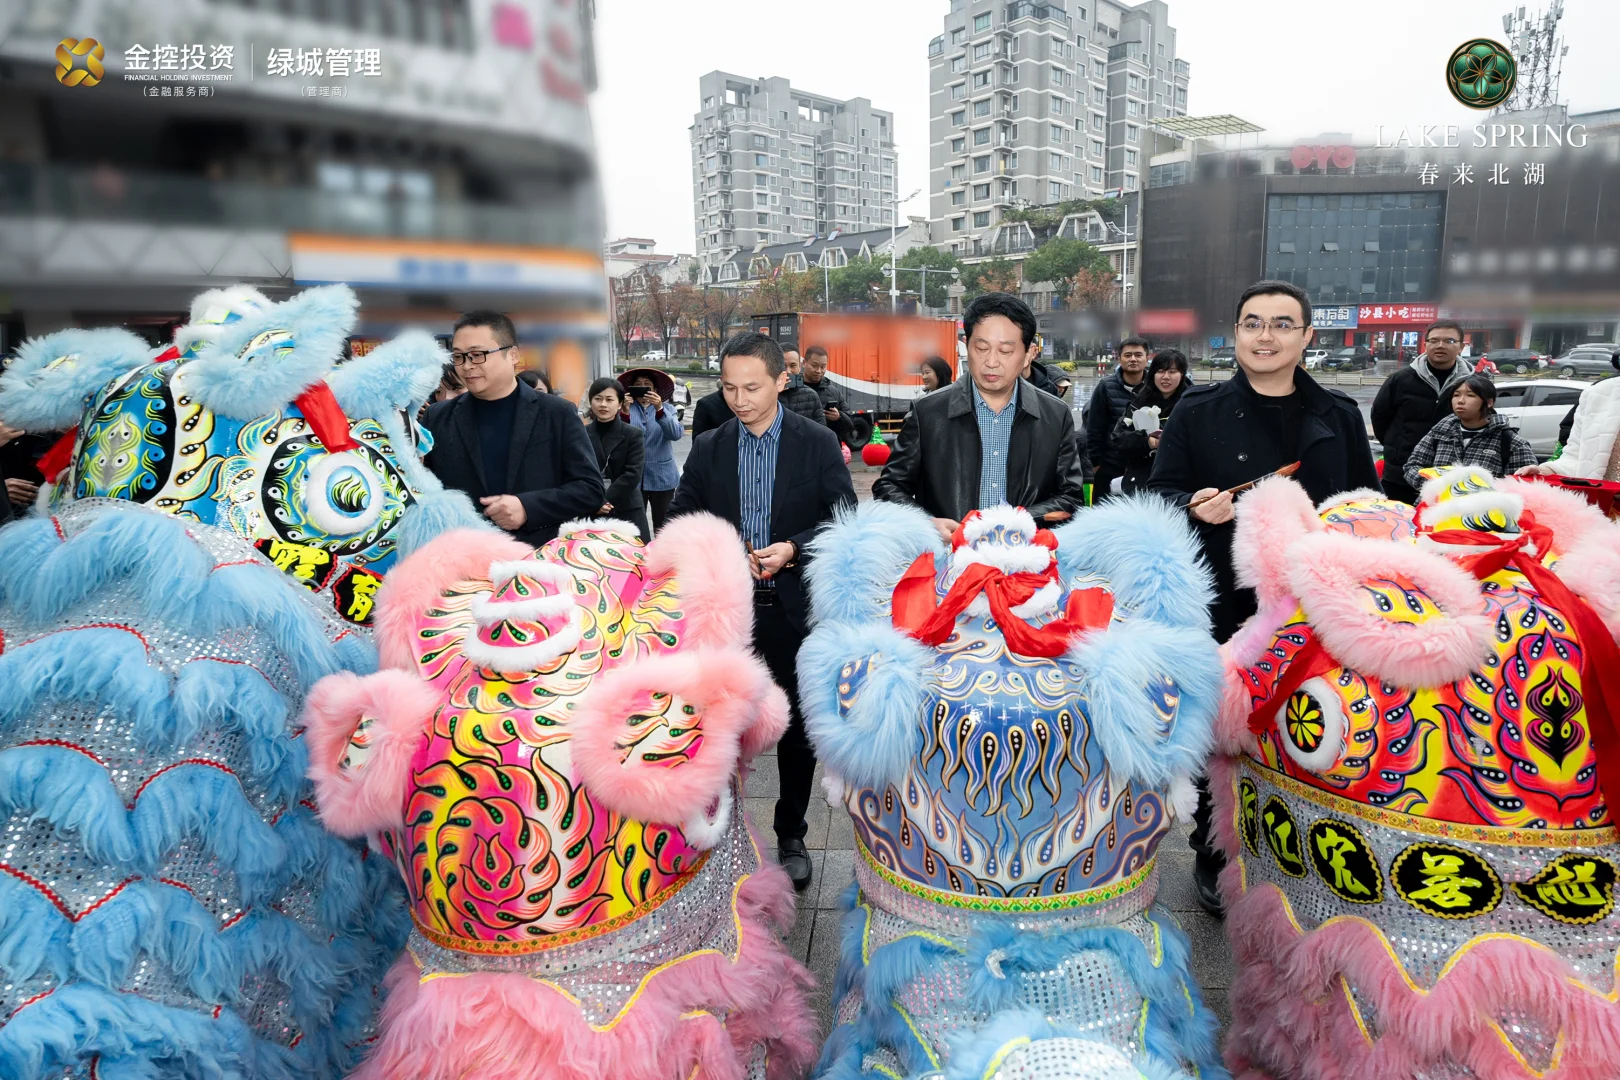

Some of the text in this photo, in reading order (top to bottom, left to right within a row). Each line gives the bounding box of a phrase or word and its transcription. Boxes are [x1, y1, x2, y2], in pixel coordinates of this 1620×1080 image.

[1291, 145, 1356, 169] OYO
[1360, 306, 1410, 318] 沙县小吃
